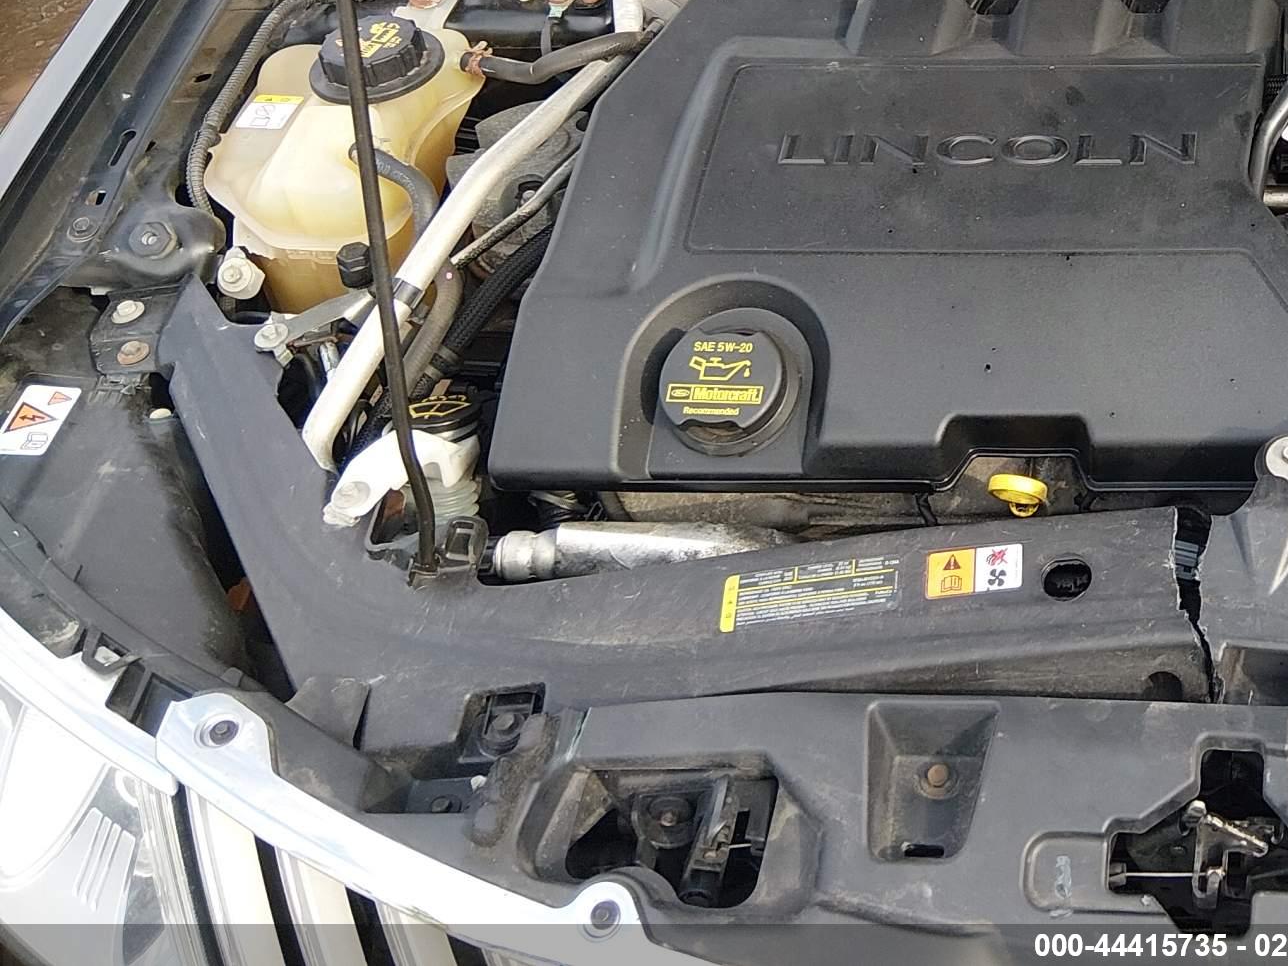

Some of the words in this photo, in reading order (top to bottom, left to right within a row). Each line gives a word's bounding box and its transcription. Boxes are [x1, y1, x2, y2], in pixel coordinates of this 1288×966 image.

[776, 131, 1199, 166] LINCOLN
[694, 341, 715, 352] SAE
[717, 342, 753, 352] 5W-20
[683, 406, 740, 416] Recommended
